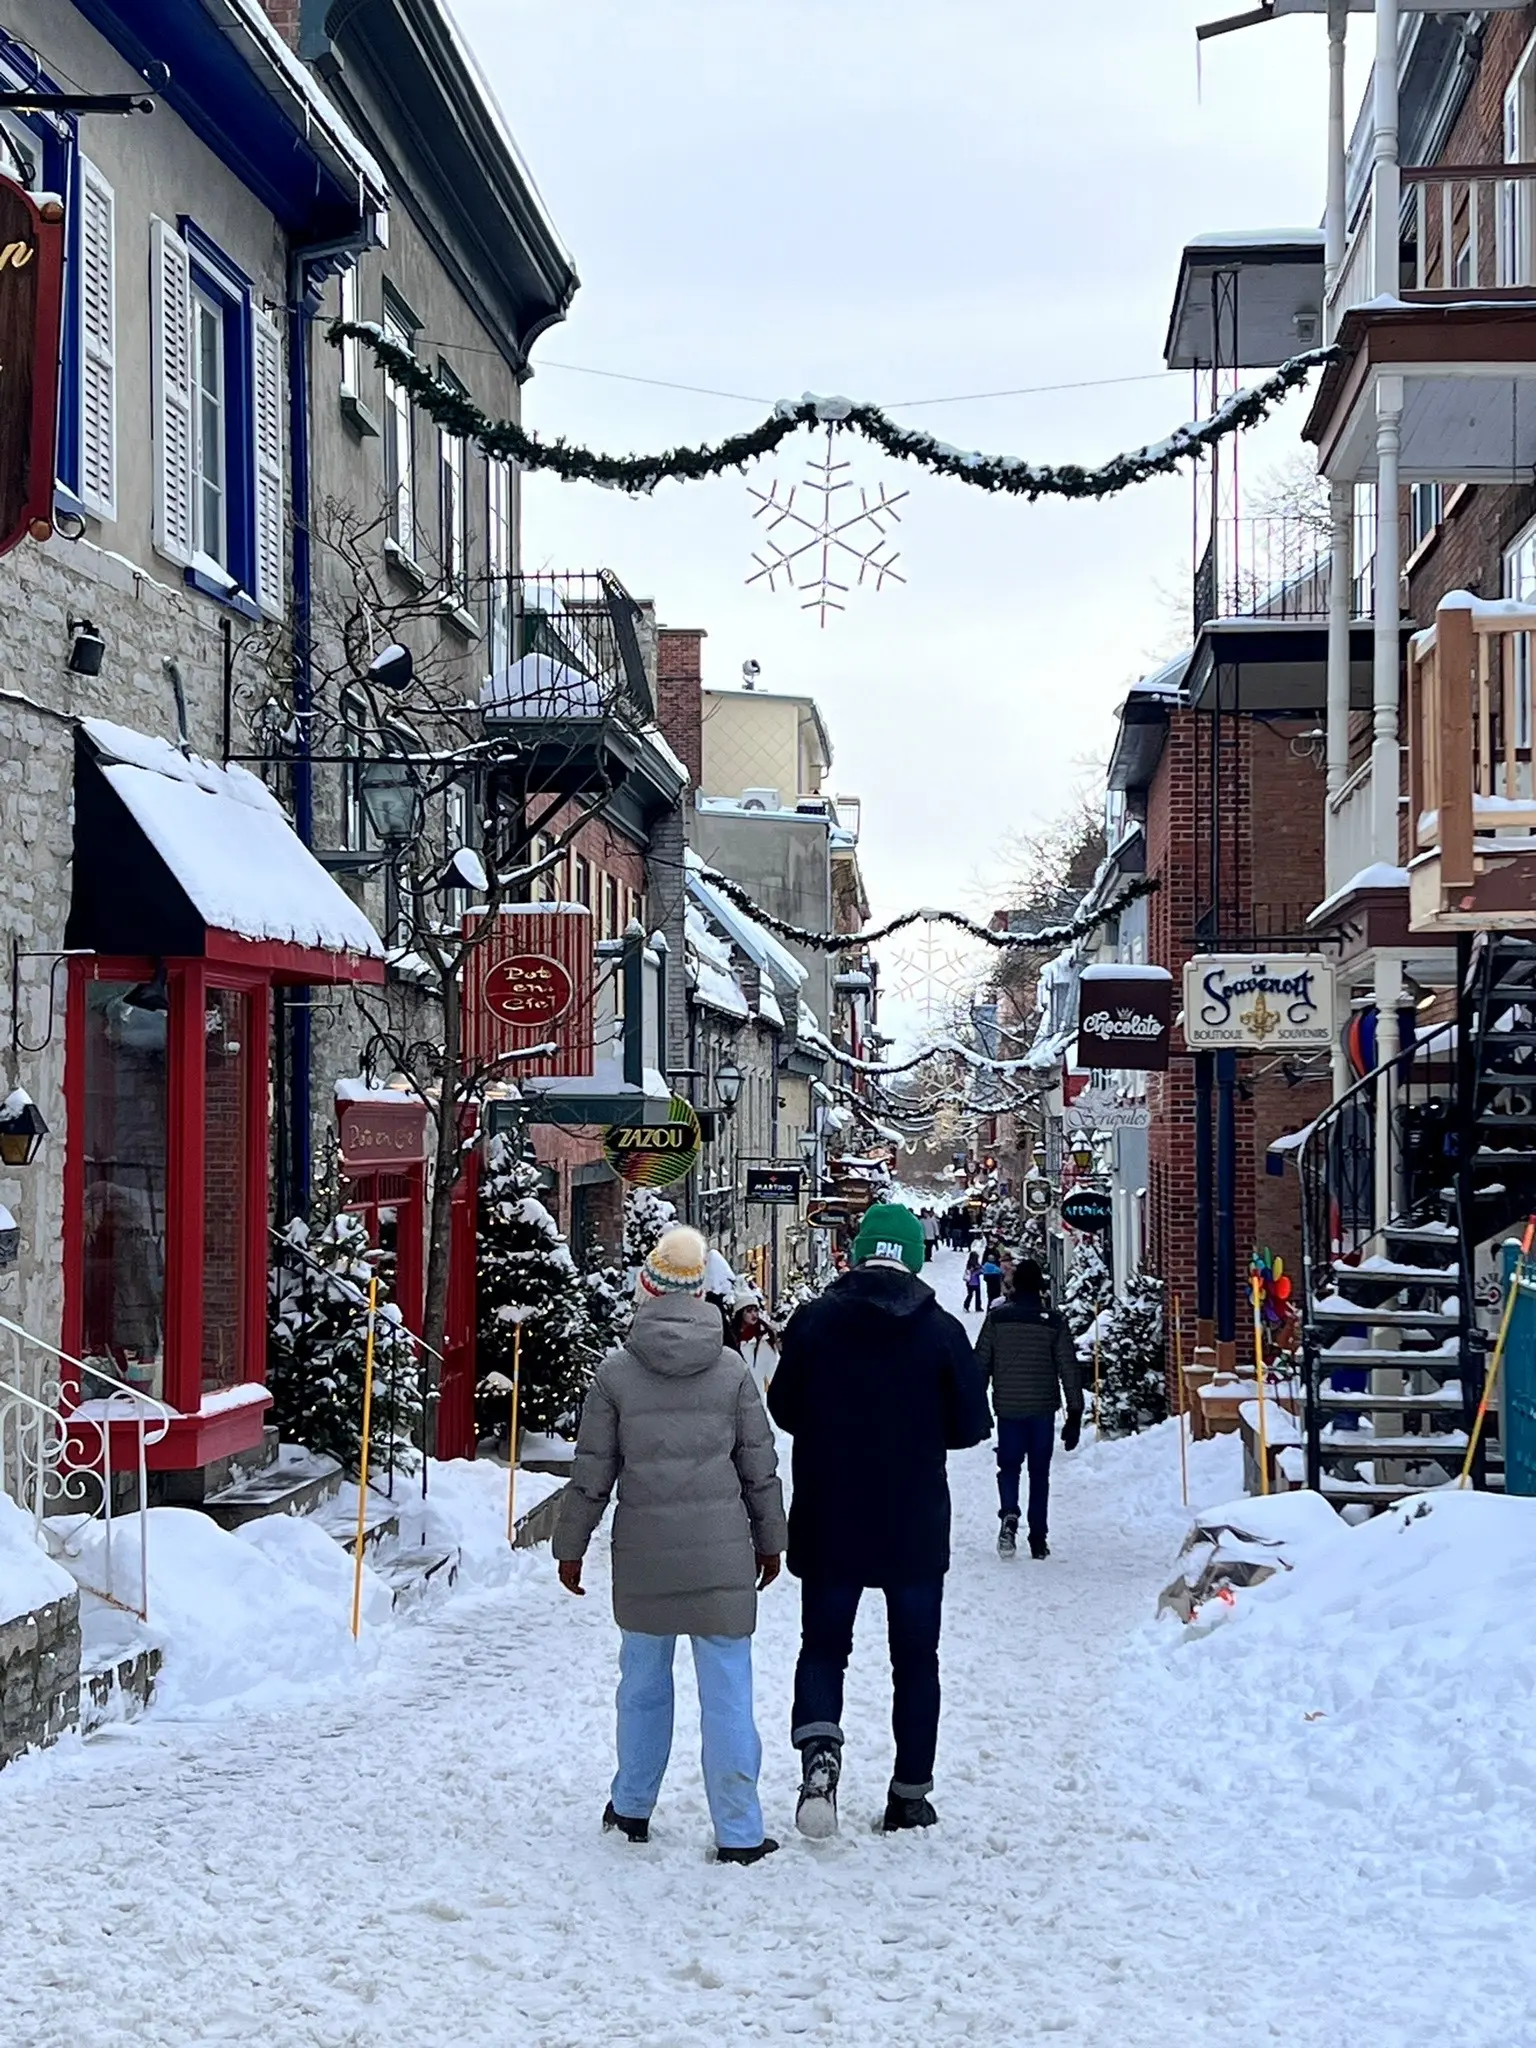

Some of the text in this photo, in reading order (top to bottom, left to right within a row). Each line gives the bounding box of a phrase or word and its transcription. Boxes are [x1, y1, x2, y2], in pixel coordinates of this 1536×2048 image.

[1083, 1011, 1165, 1041] Chocolato
[1194, 1028, 1331, 1040] BOUTIQUE SOUVENIRS
[617, 1128, 683, 1148] ZAZOU
